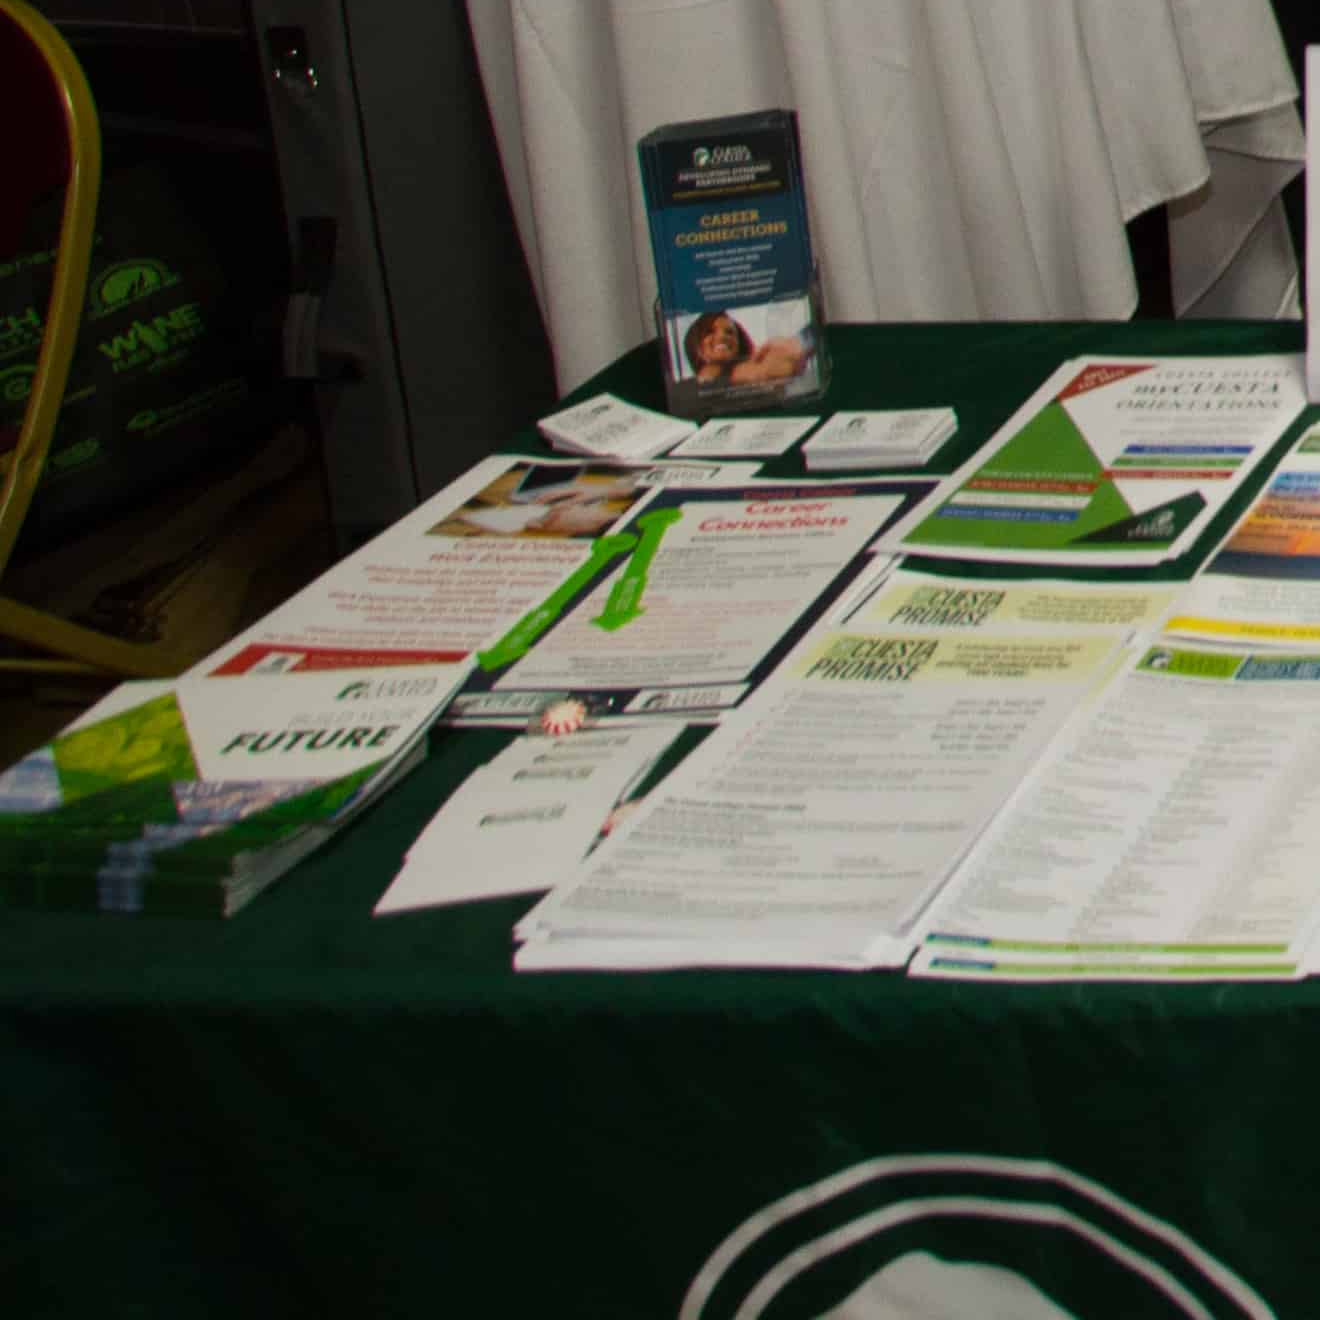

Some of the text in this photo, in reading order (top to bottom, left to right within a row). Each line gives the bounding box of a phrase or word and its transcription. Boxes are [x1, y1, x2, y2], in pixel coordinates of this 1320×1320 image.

[744, 500, 832, 515] Career
[698, 515, 849, 533] Connections
[929, 588, 1007, 607] CUESTA
[888, 605, 990, 627] PROMISE
[849, 638, 940, 660] CUESTA
[805, 658, 923, 681] PROMISE
[221, 726, 402, 755] FUTURE
